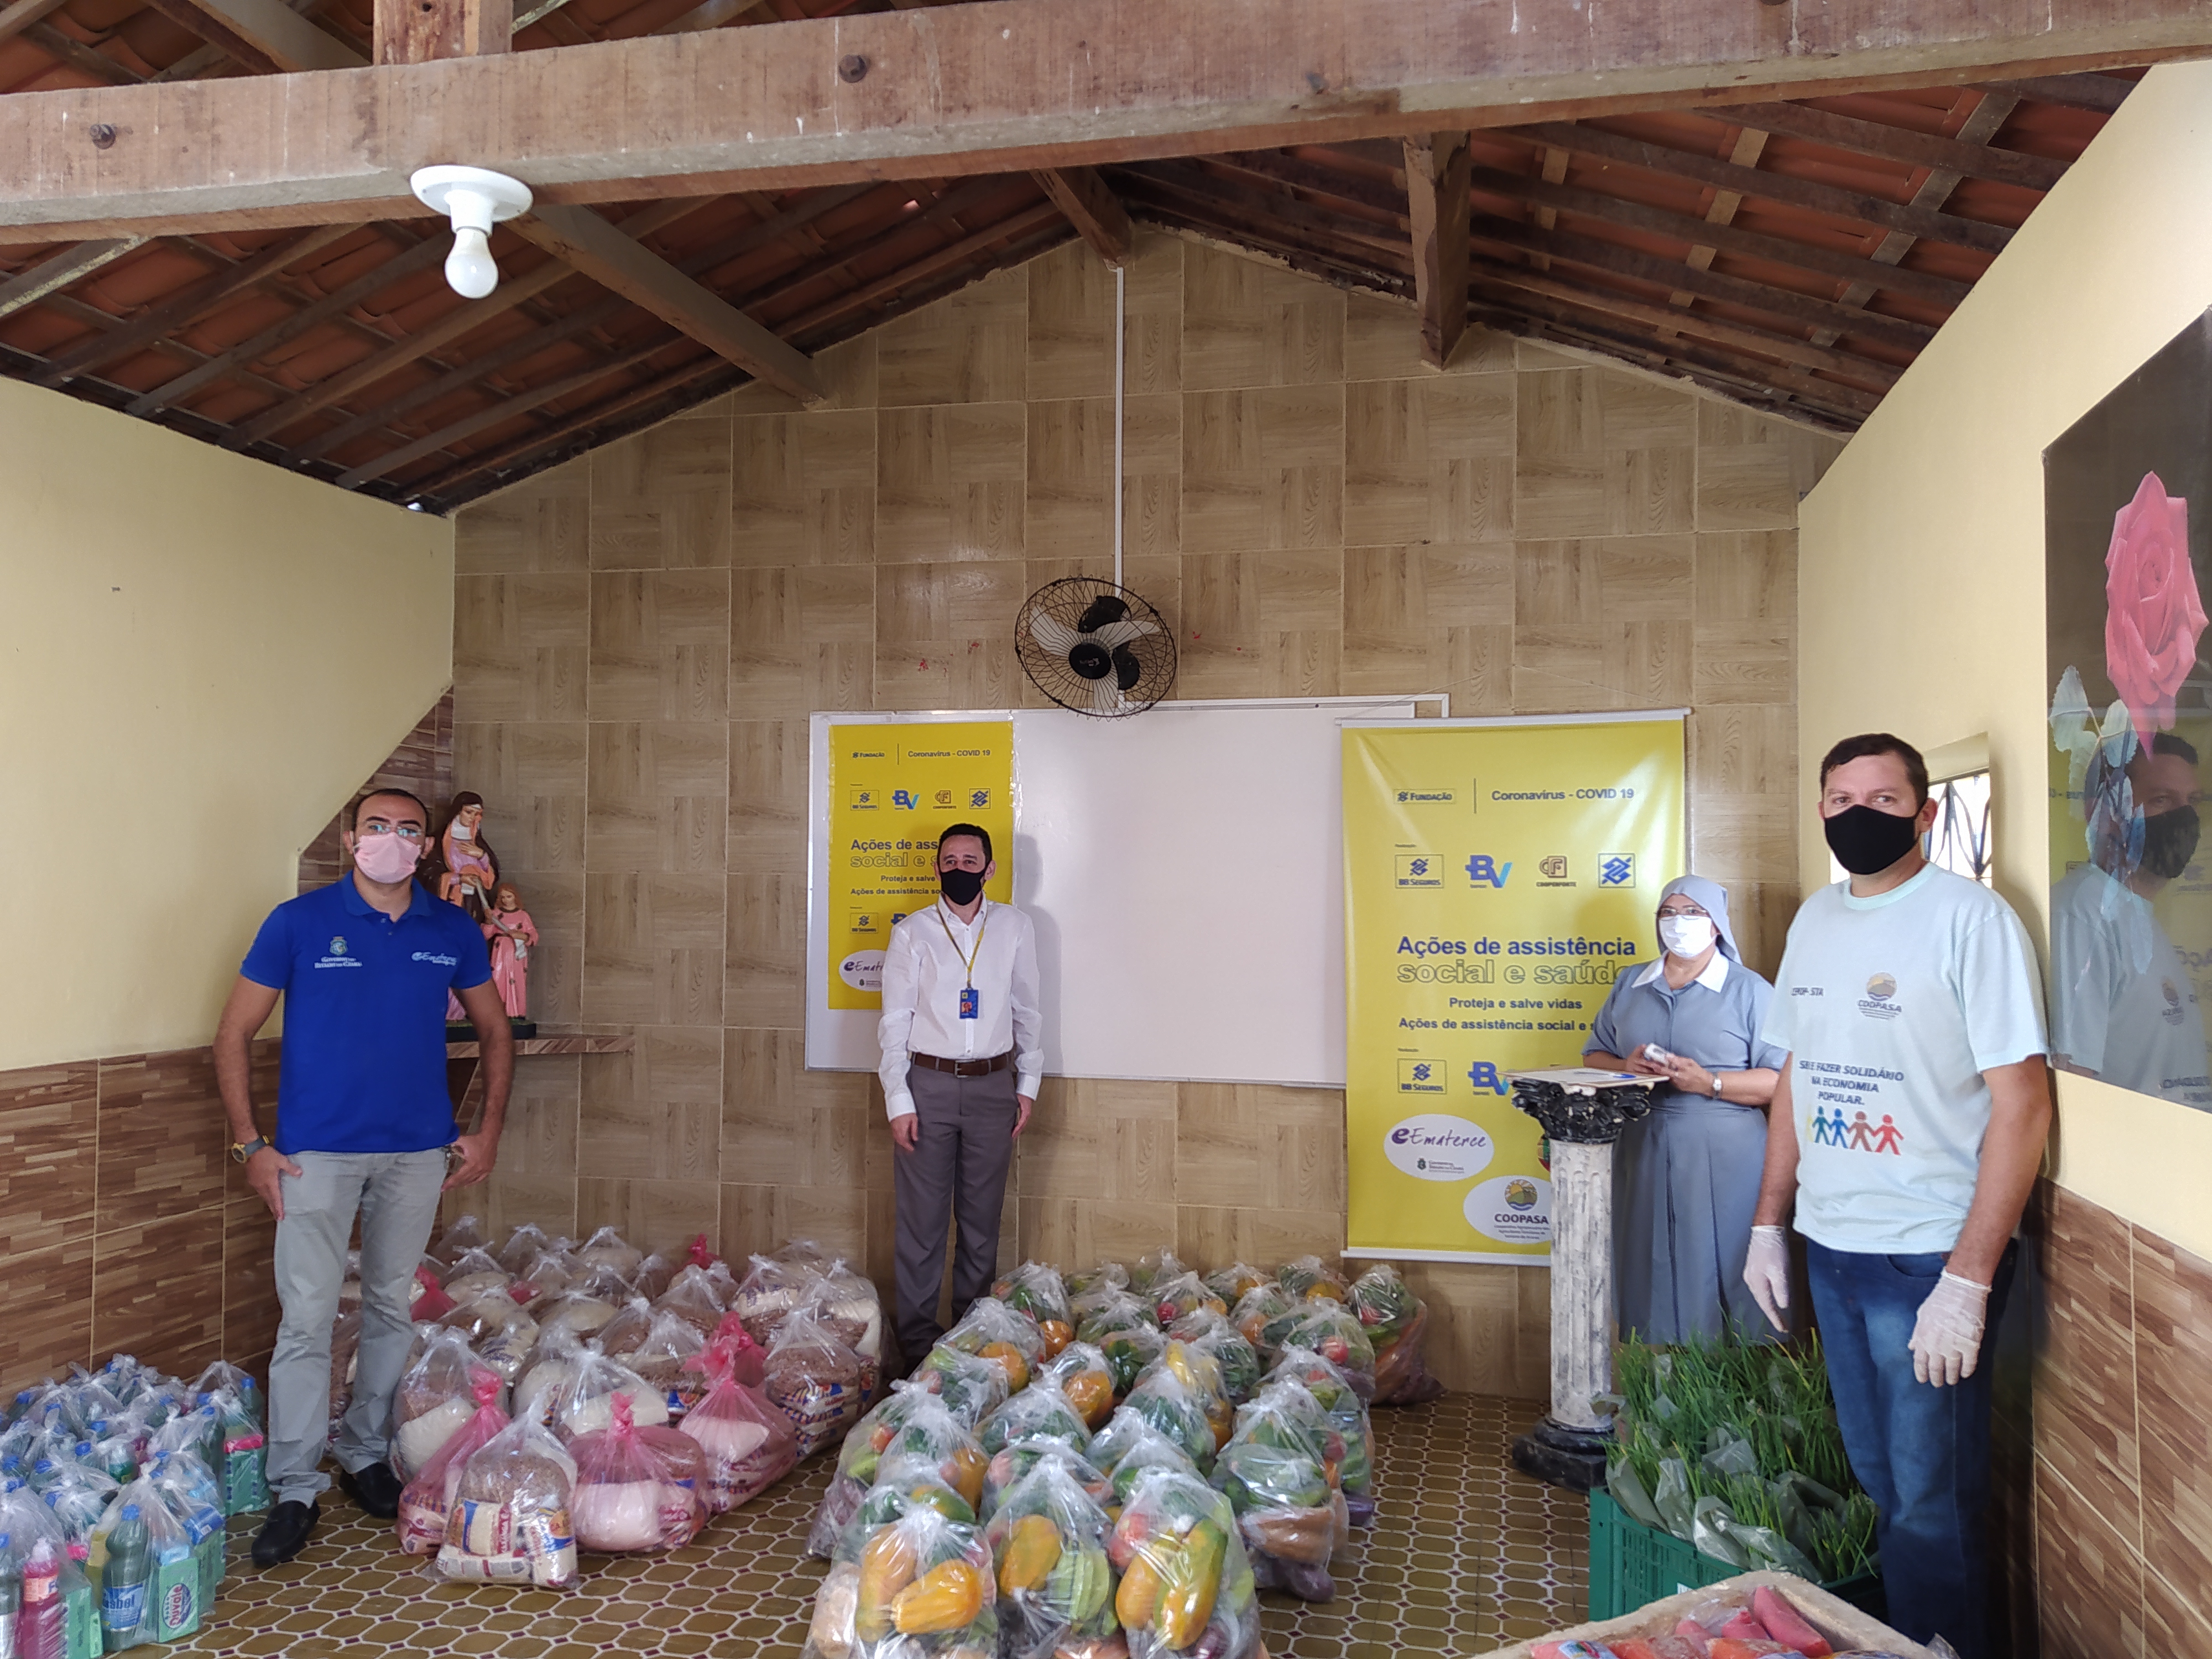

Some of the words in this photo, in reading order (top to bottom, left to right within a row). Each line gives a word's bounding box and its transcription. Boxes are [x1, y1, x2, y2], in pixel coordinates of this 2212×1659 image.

[1575, 789, 1617, 800] COVID
[1620, 788, 1635, 799] 19
[851, 839, 892, 853] Ações
[896, 839, 912, 850] de
[916, 841, 938, 850] ass
[851, 852, 909, 868] social
[913, 855, 926, 868] e
[1397, 936, 1467, 958] Ações
[1474, 937, 1501, 956] de
[1507, 936, 1636, 956] assistência
[1397, 958, 1495, 984] social
[1503, 965, 1526, 984] e
[1534, 959, 1629, 985] saúd
[1449, 997, 1495, 1010] Proteja
[1499, 1000, 1506, 1009] e
[1510, 998, 1544, 1009] salve
[1547, 998, 1583, 1009] vidas
[1399, 1017, 1437, 1030] Ações
[1442, 1018, 1456, 1029] de
[1461, 1018, 1533, 1030] assistência
[1537, 1019, 1575, 1031] social
[1579, 1022, 1586, 1031] e
[1842, 1065, 1905, 1081] SOLIDÁRIO
[1823, 1077, 1880, 1093] ECONOMIA
